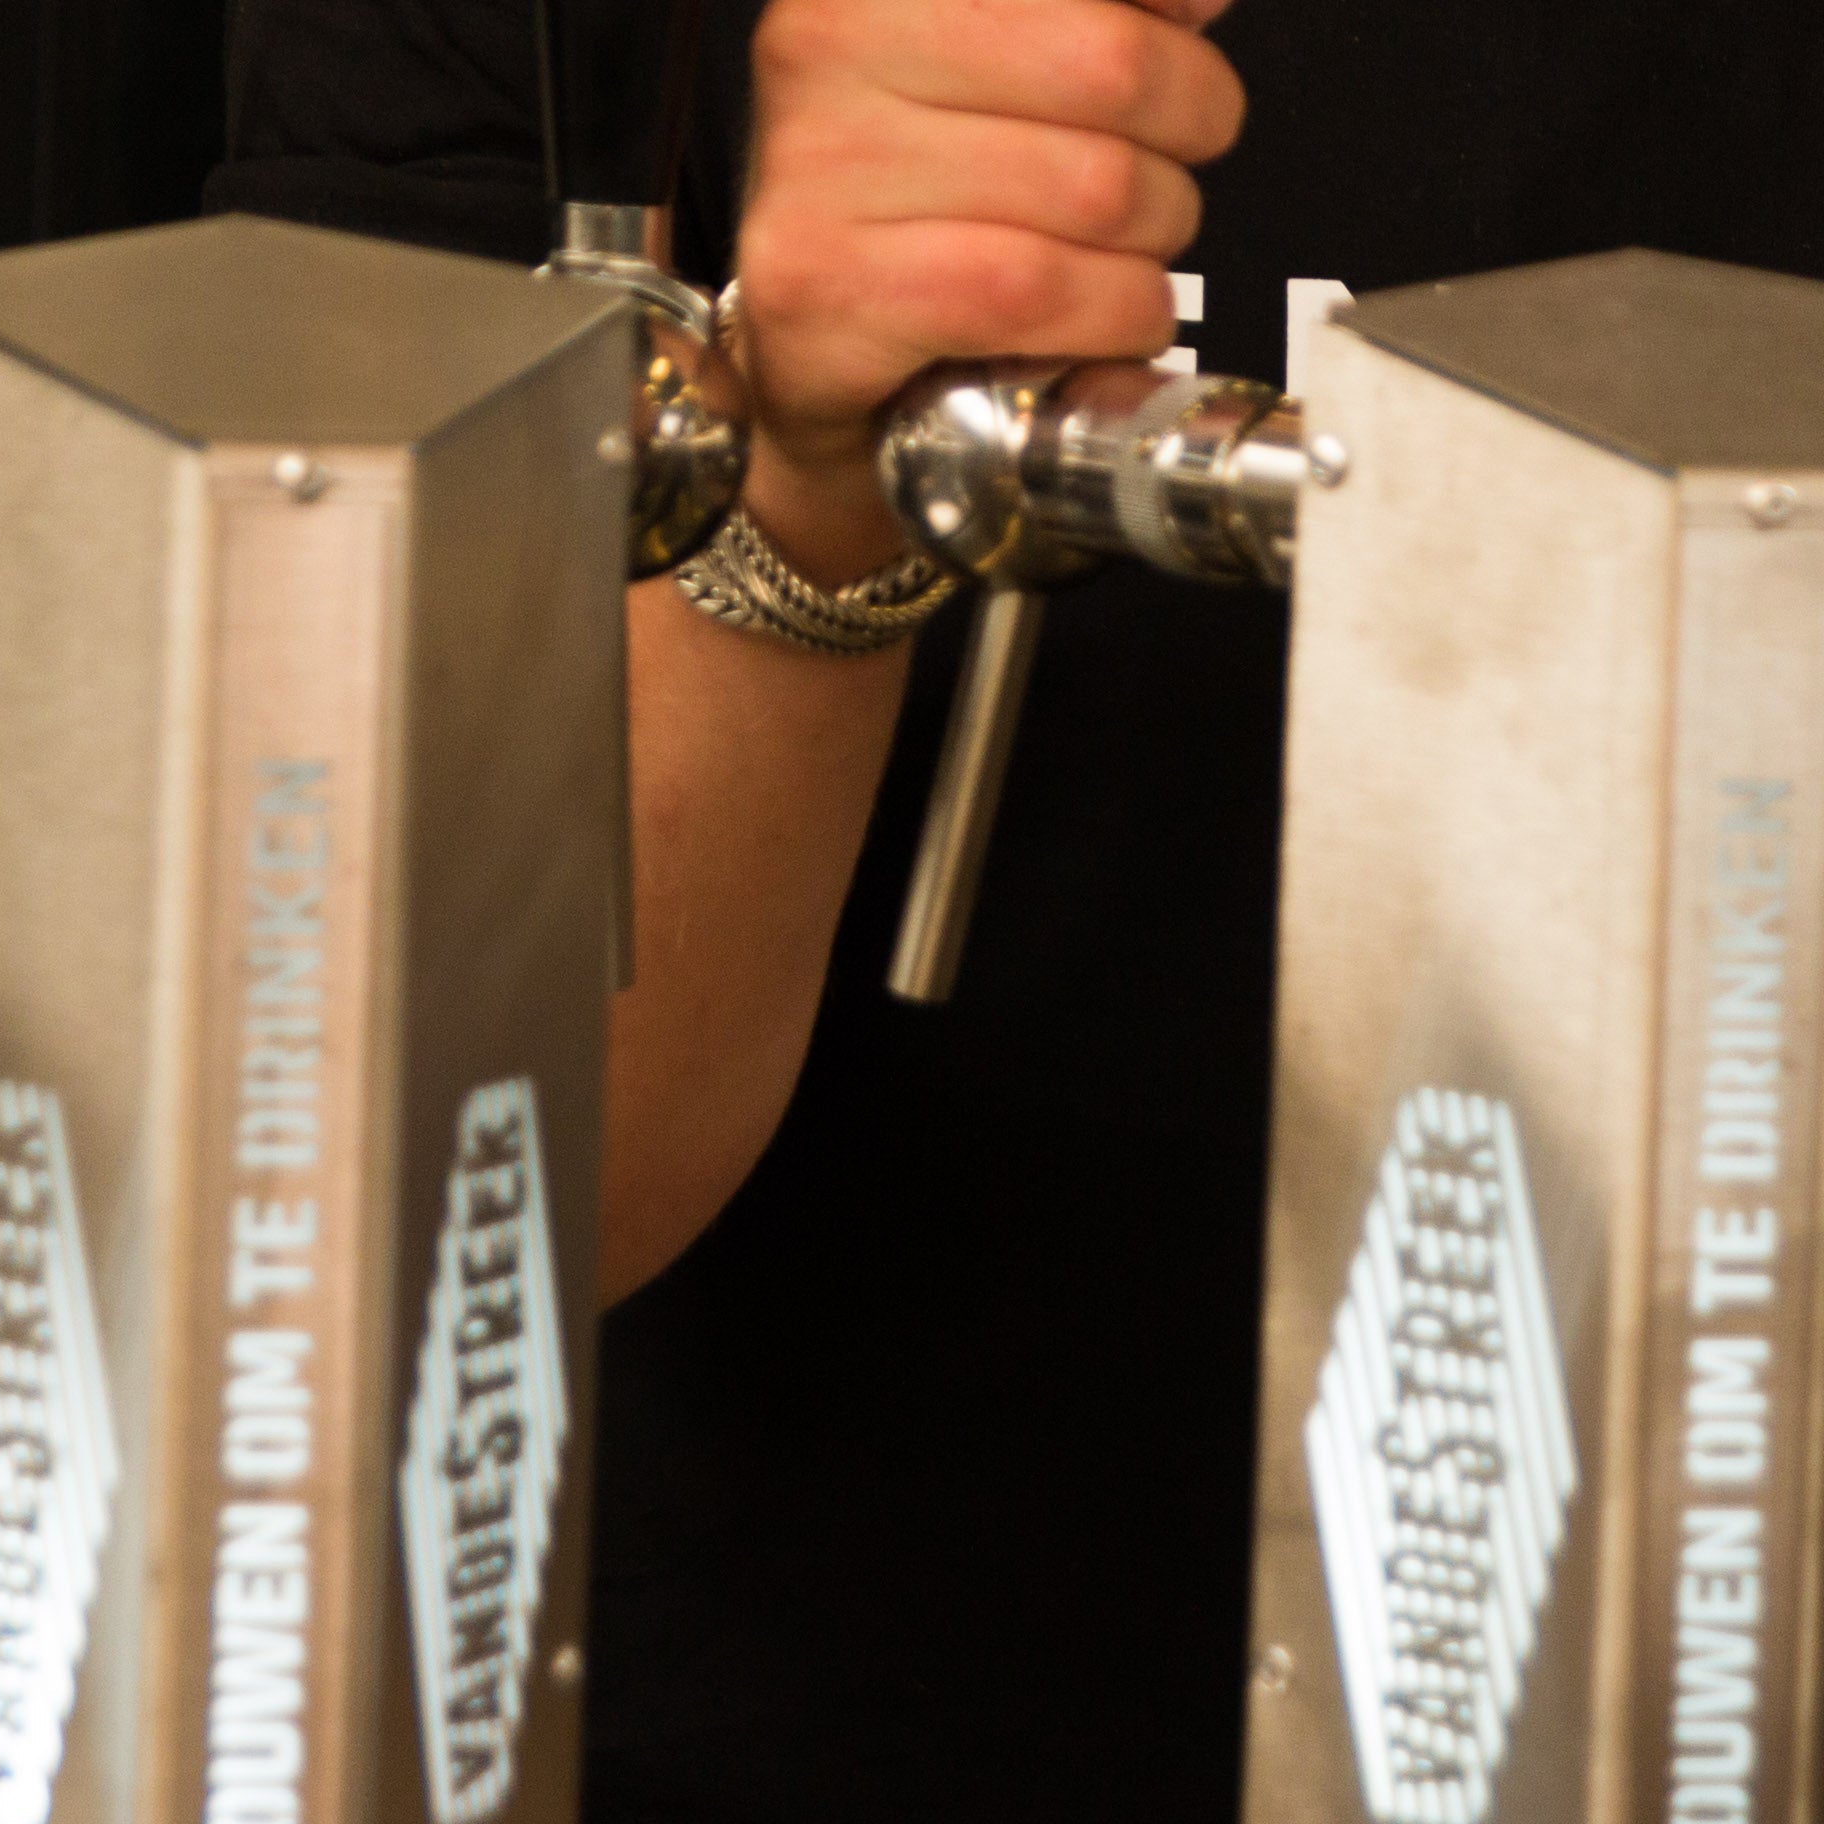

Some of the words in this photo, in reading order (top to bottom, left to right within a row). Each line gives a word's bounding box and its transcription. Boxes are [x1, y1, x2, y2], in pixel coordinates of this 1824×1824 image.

[240, 759, 328, 1169] DRINKEN
[1701, 776, 1796, 1178] DRINKEN
[229, 1198, 319, 1306] TE
[1692, 1208, 1775, 1313] TE
[222, 1331, 312, 1479] OM
[436, 1114, 523, 1792] VANDESTREEK
[1372, 1128, 1504, 1787] VANDESTREEK
[1683, 1338, 1770, 1481] OM
